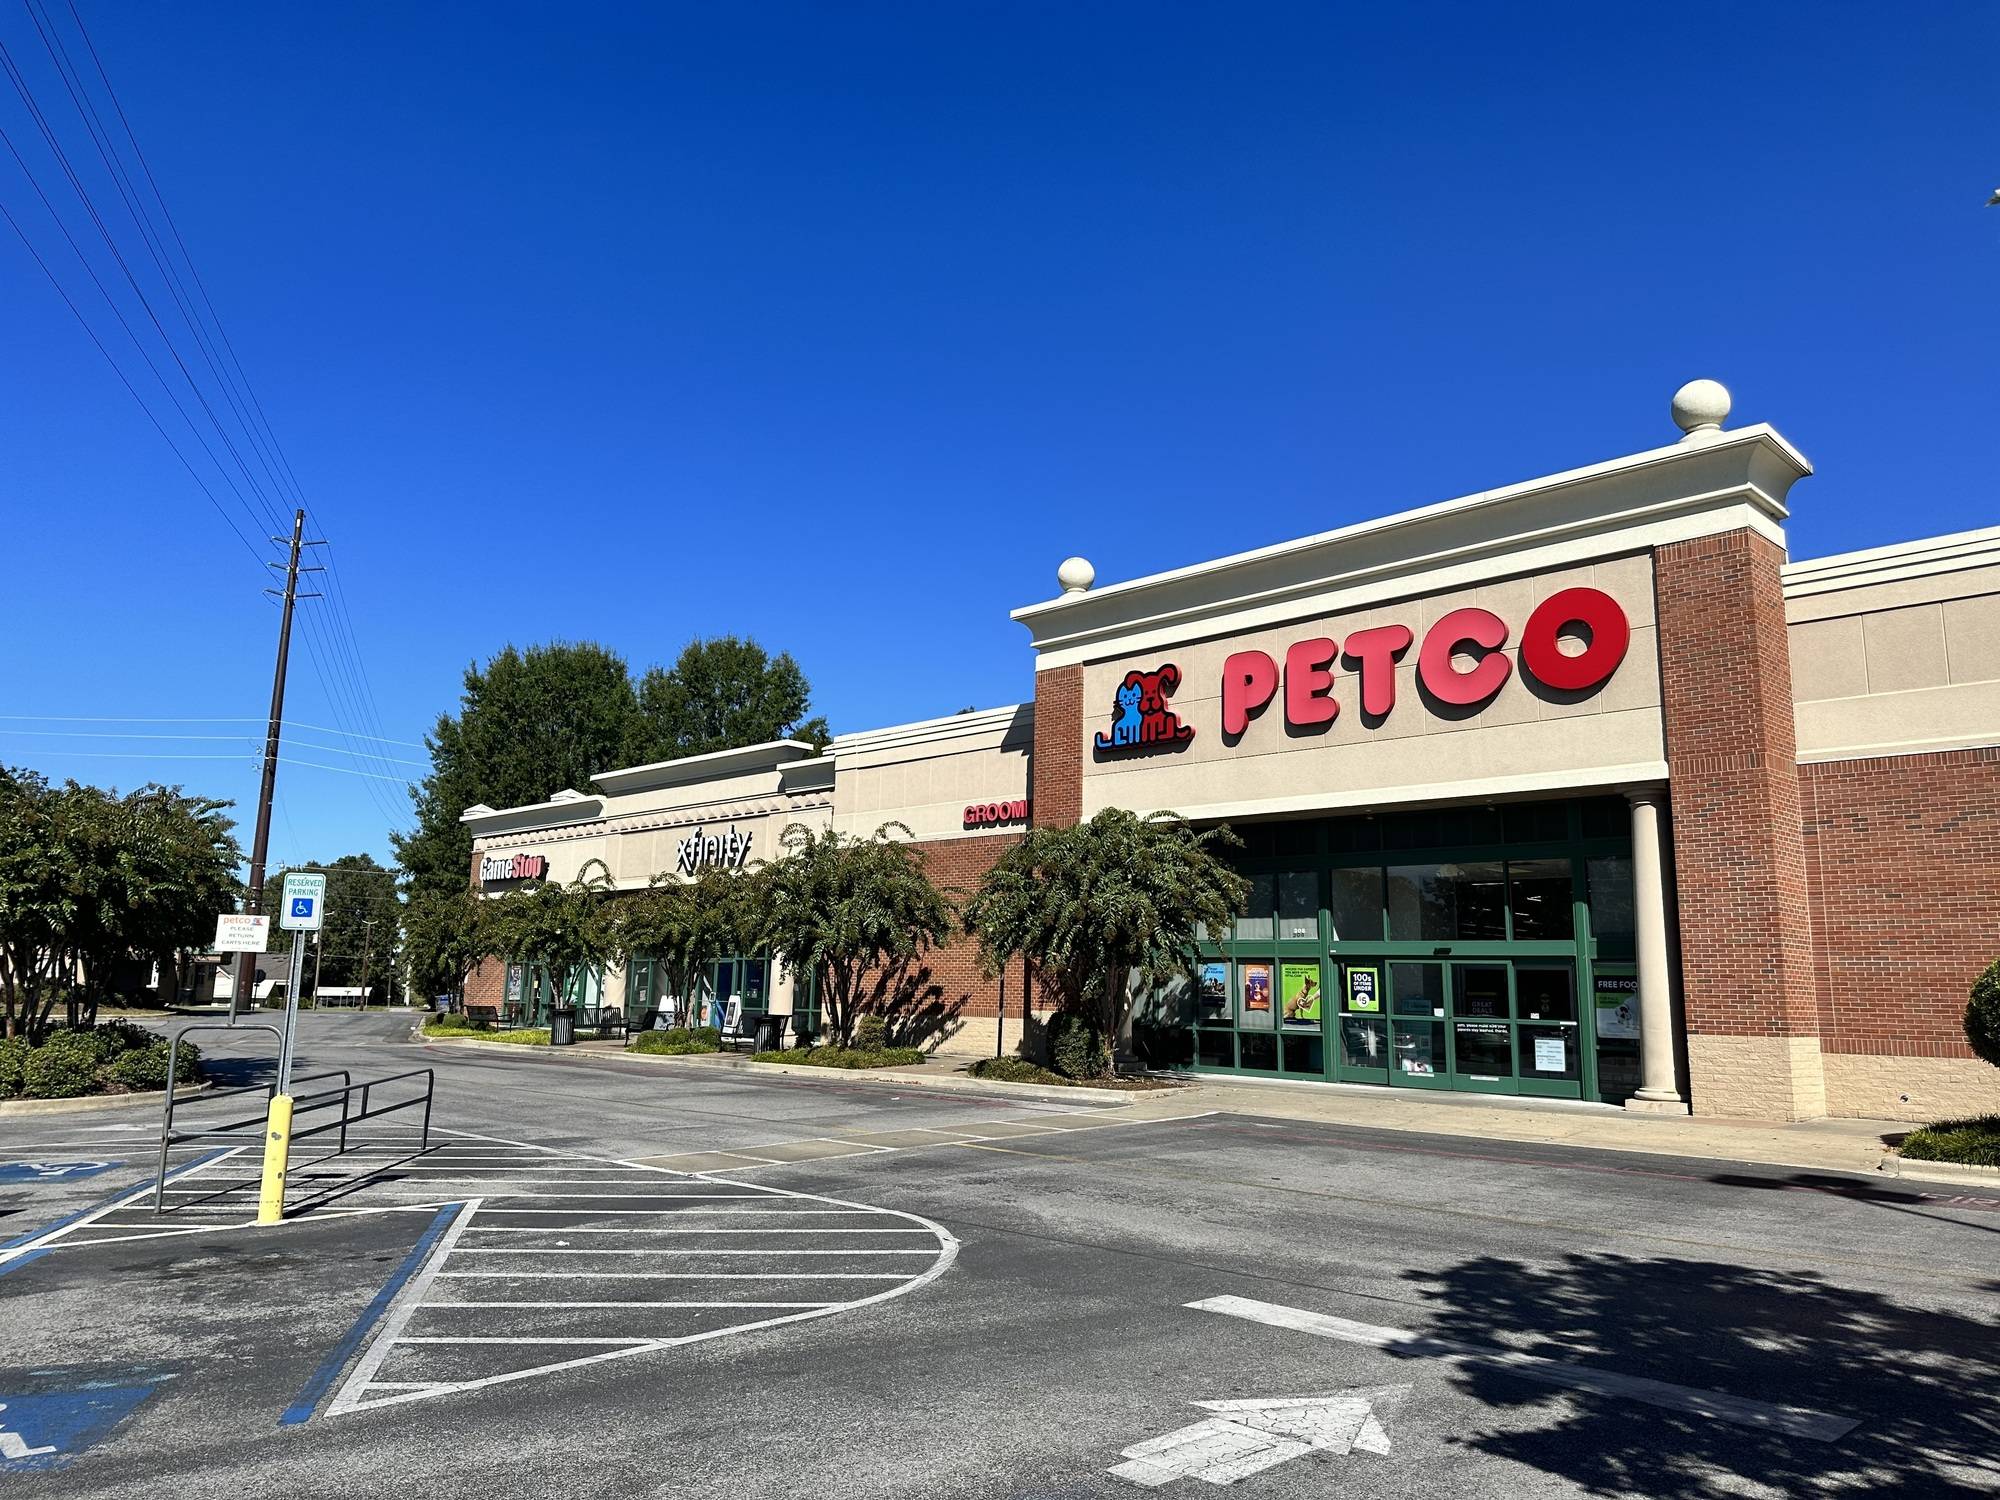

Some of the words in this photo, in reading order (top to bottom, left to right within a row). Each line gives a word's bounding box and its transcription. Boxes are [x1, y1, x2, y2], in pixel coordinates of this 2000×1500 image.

[1223, 587, 1630, 734] PETCO
[964, 800, 1027, 823] GROOM
[677, 825, 751, 872] xfinity
[479, 854, 542, 880] GameStop
[287, 878, 323, 887] RESERVED
[288, 888, 319, 897] PARKING
[223, 916, 251, 925] petco
[1598, 980, 1618, 989] FREE
